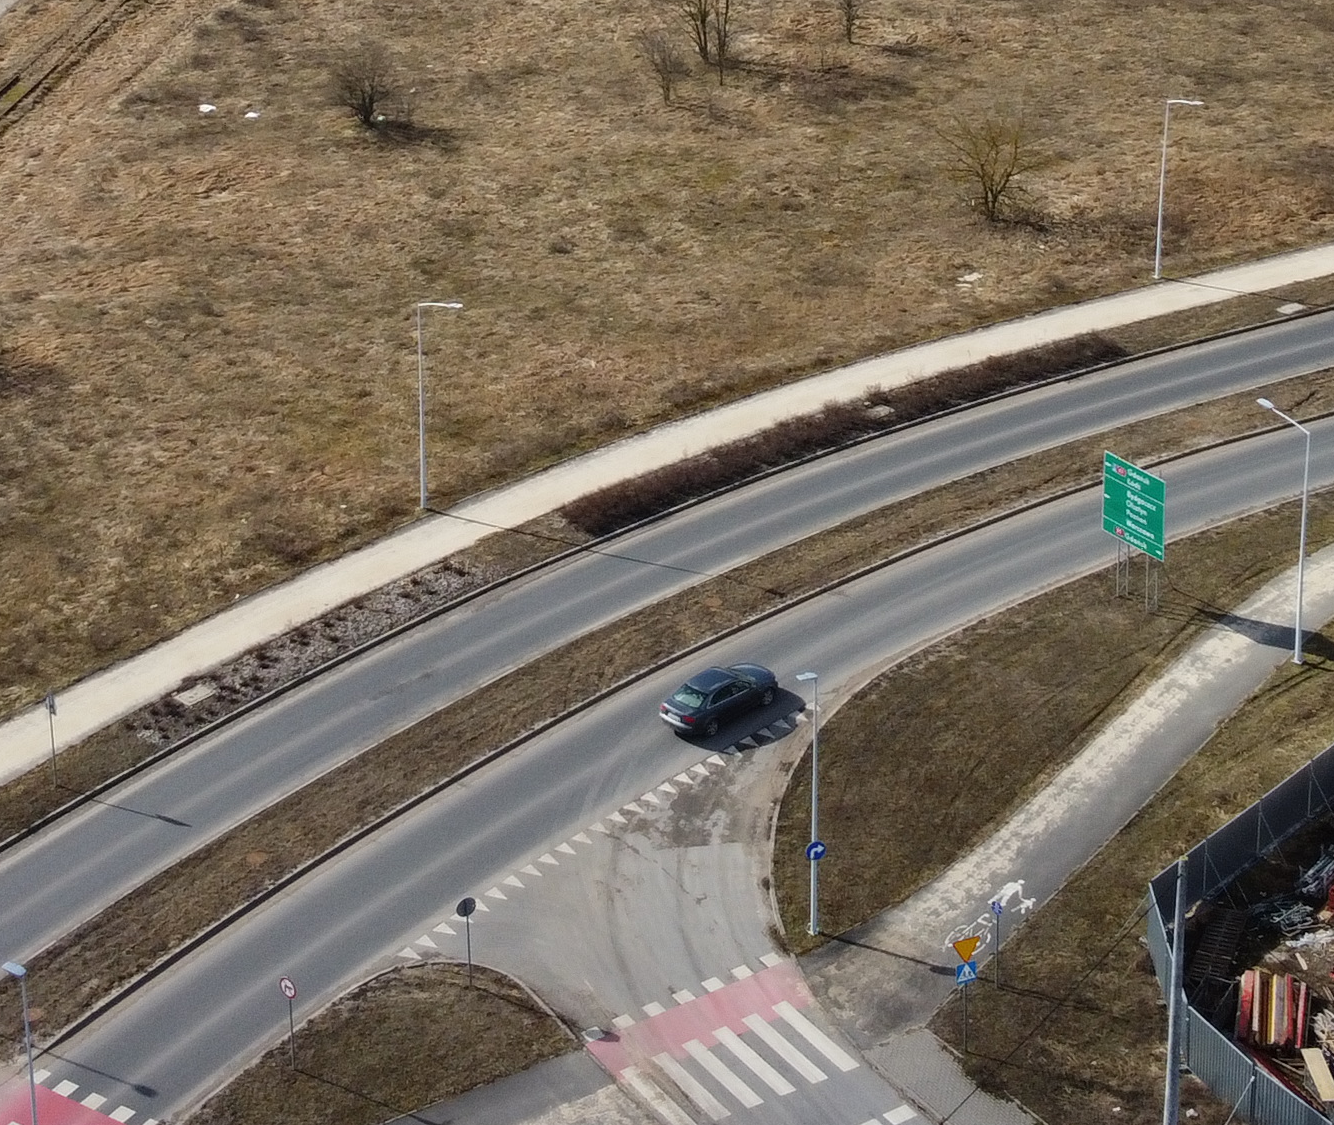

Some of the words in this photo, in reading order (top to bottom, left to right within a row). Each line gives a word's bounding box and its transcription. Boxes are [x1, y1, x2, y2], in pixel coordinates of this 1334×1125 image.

[1125, 500, 1148, 517] Olsztyn
[1126, 490, 1157, 512] Bydgoszcz
[1125, 519, 1155, 540] Warszawa
